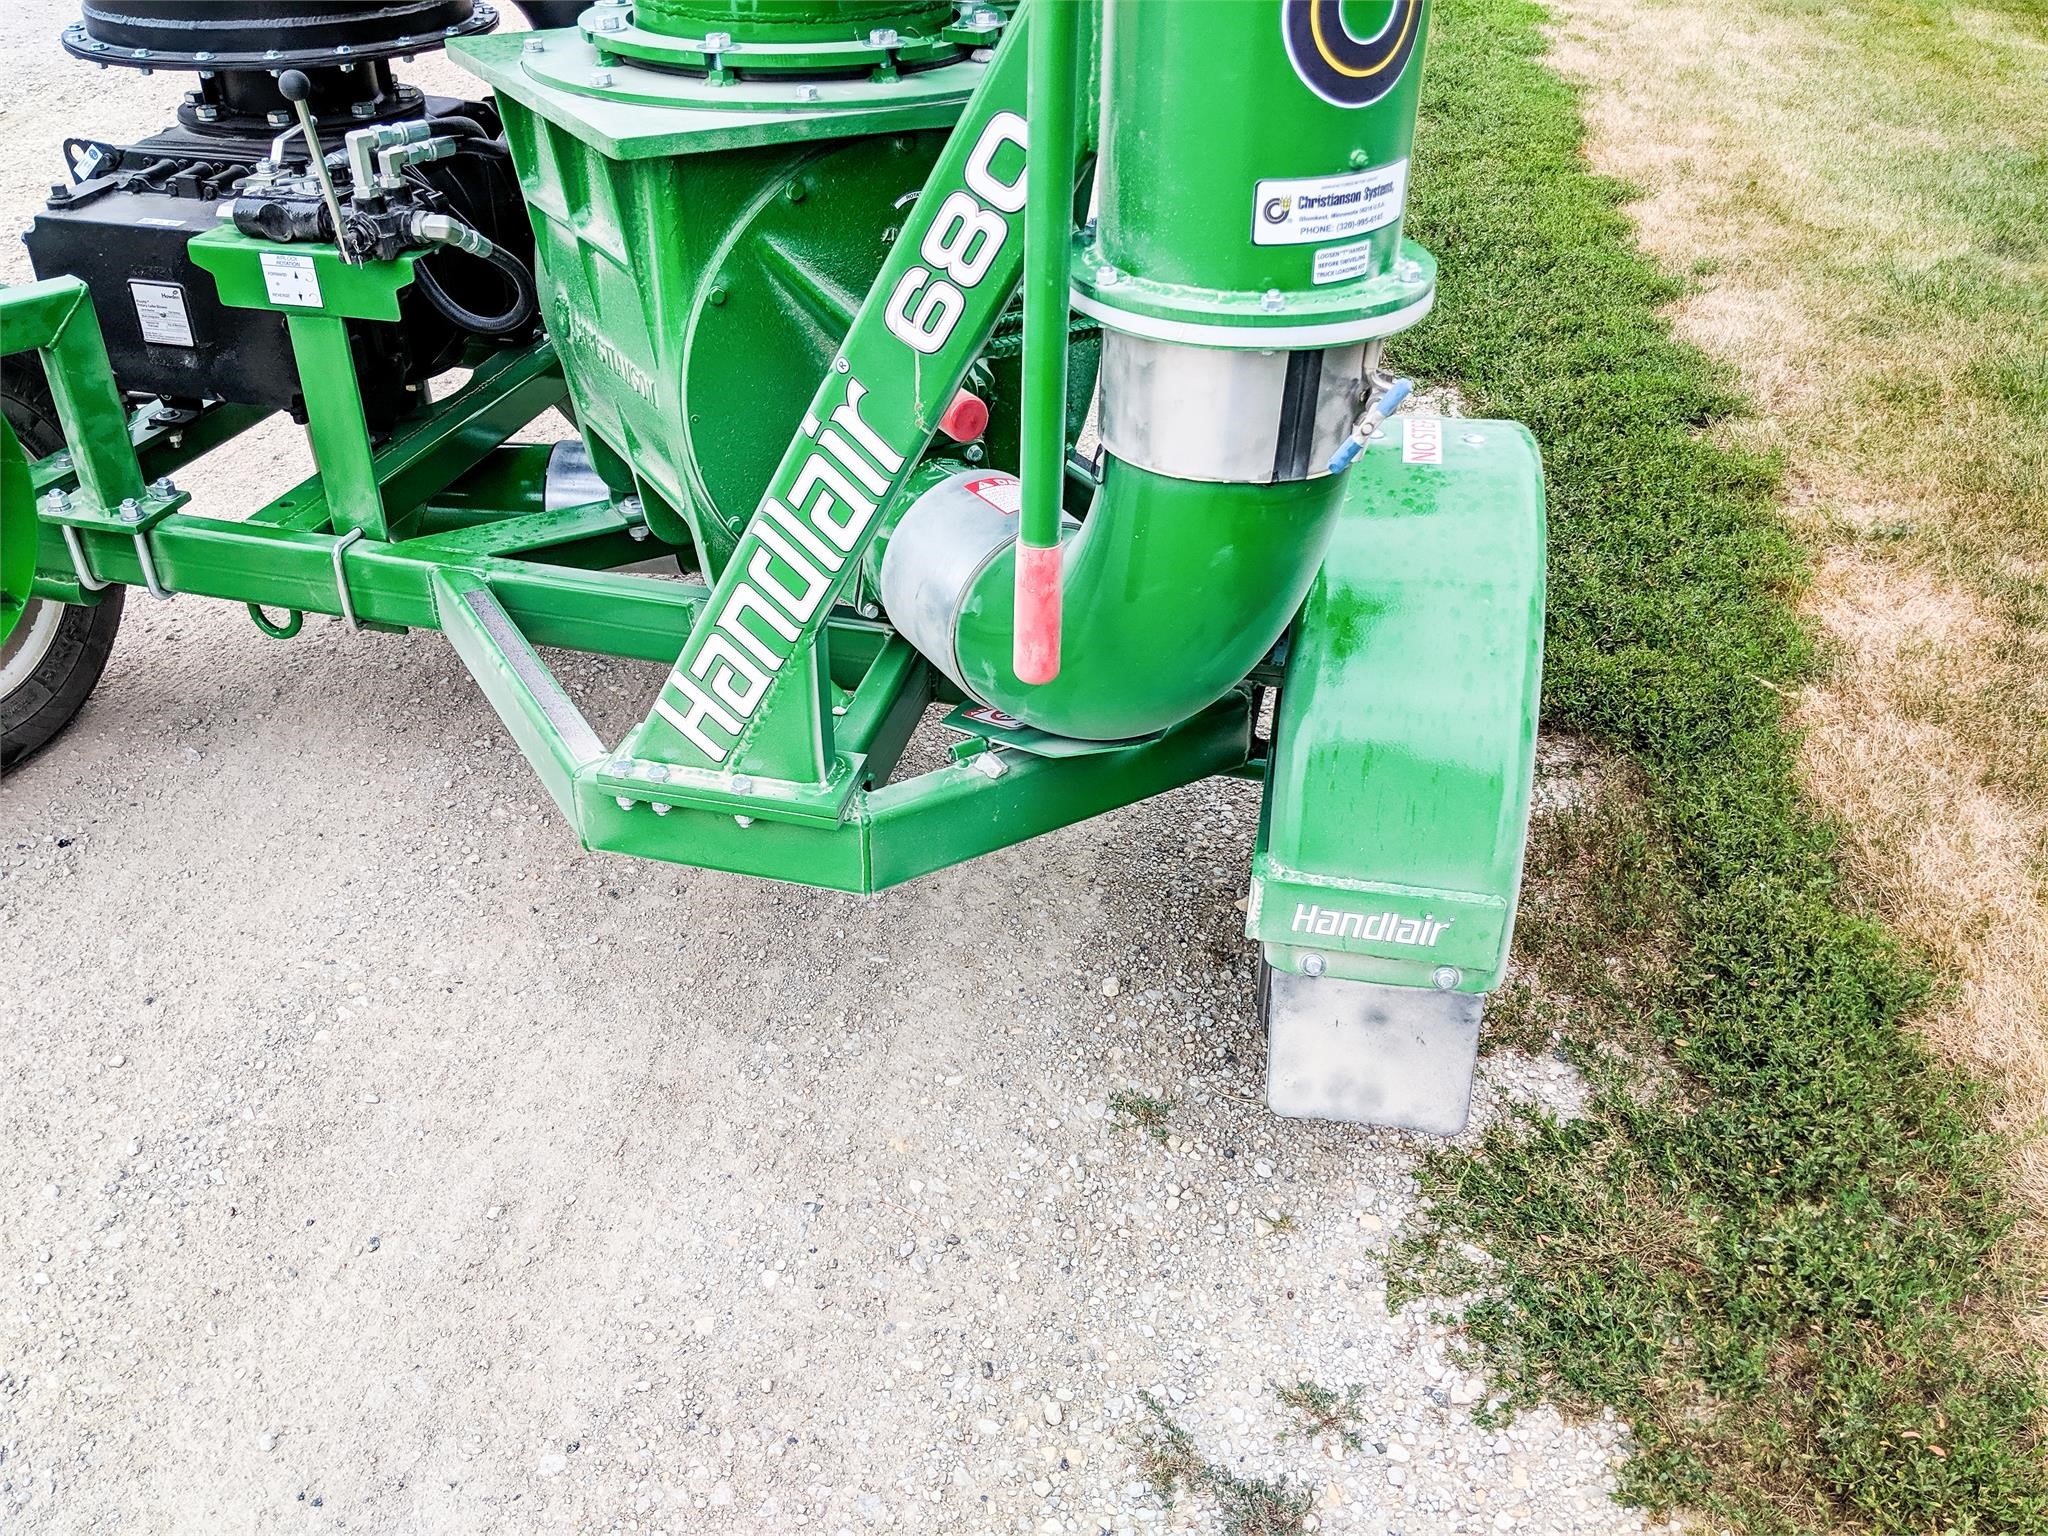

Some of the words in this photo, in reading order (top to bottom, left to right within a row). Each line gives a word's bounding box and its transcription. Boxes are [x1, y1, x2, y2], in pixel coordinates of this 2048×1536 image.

[1298, 190, 1361, 210] Christianson
[884, 111, 1027, 354] 680
[1410, 442, 1437, 462] NO
[1291, 903, 1450, 947] Handlair
